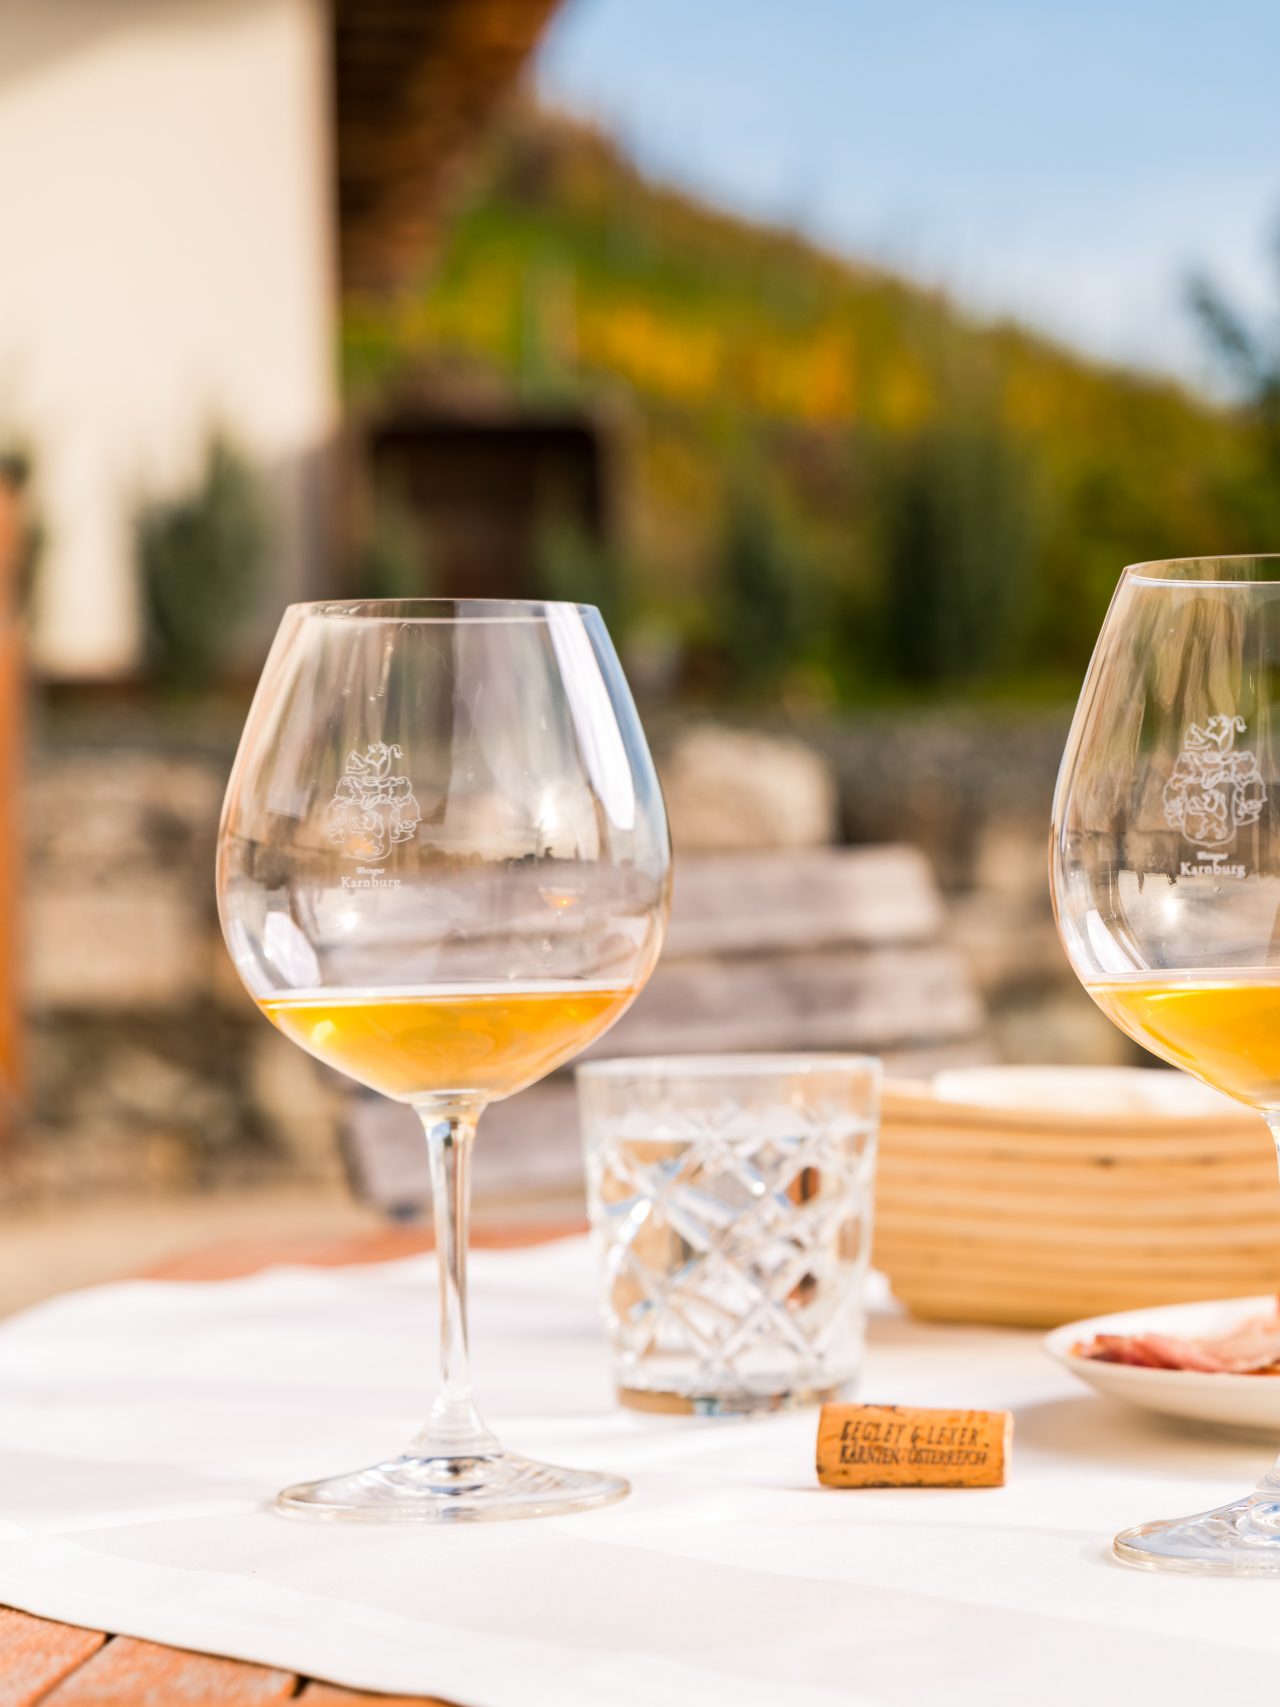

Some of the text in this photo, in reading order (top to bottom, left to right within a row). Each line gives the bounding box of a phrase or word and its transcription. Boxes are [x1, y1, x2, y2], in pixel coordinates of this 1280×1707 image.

[1180, 861, 1247, 879] Karnburg
[341, 875, 402, 889] Karnburg
[839, 1420, 906, 1445] KEGLEY
[926, 1425, 980, 1447] LEXER
